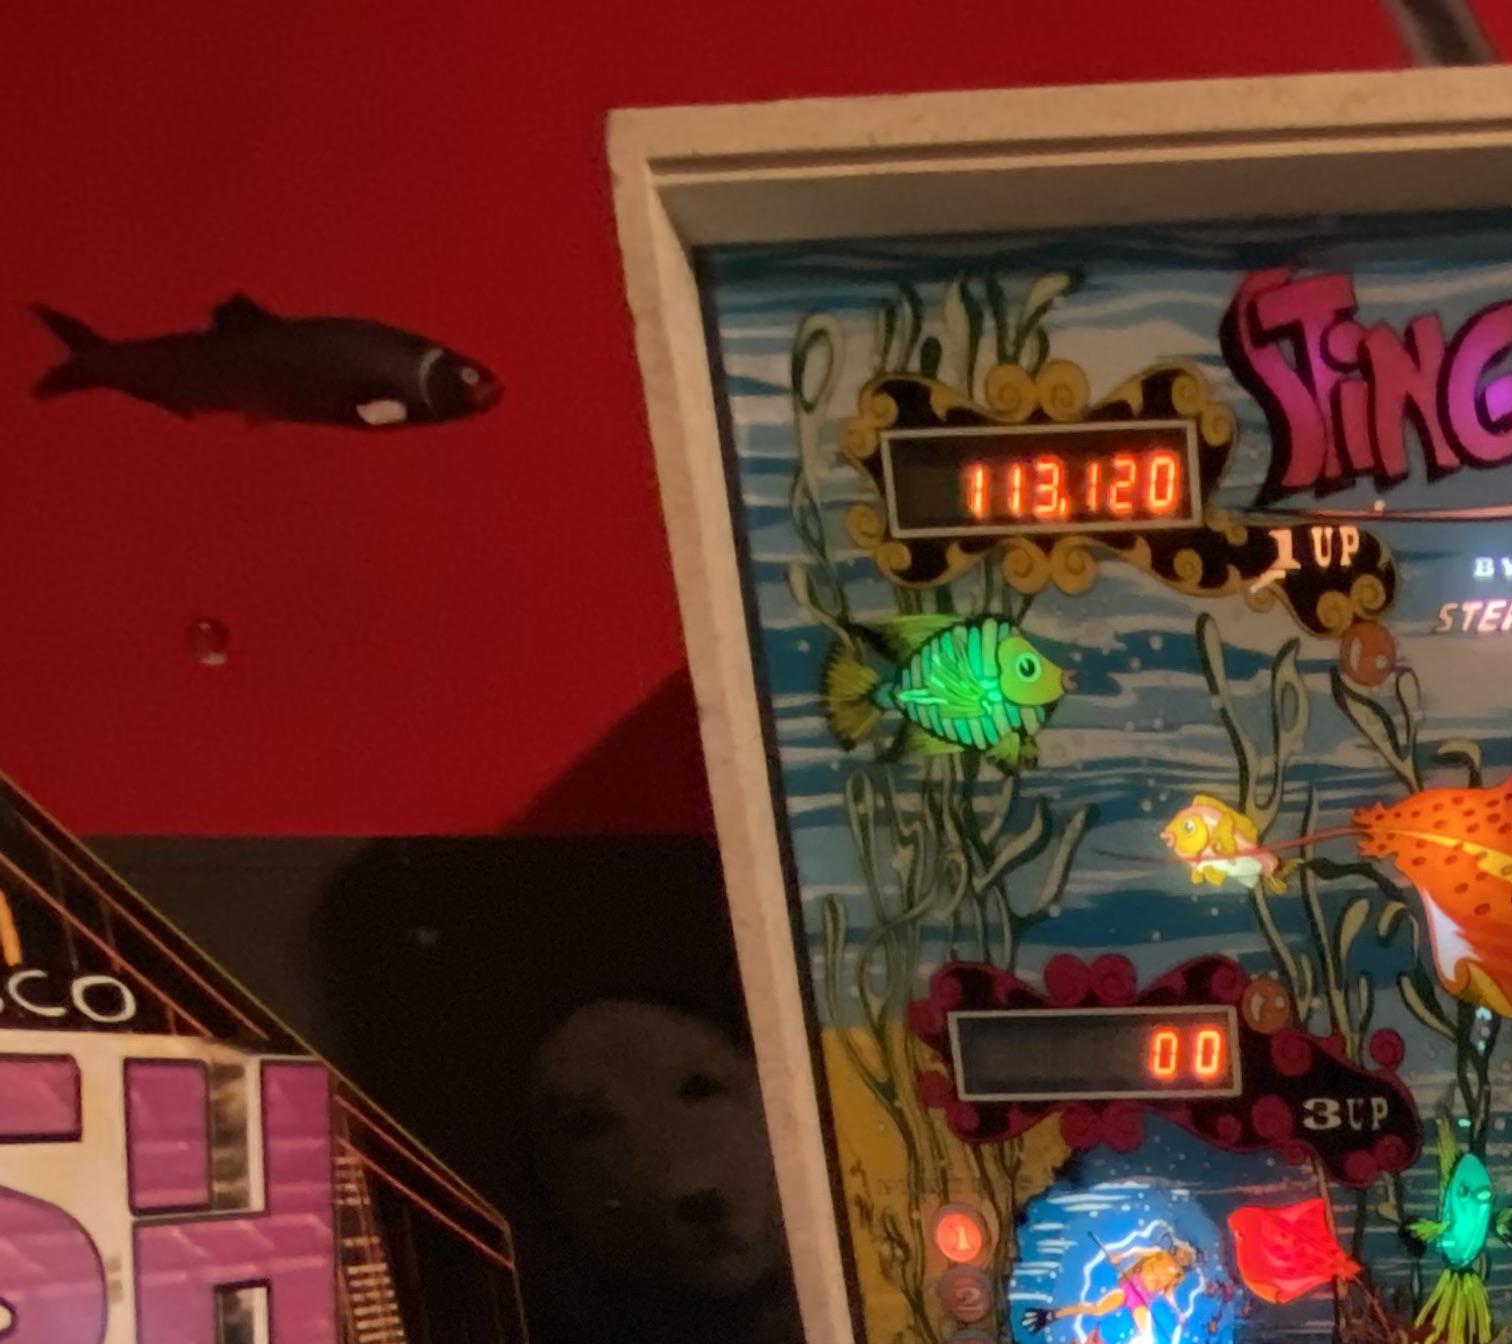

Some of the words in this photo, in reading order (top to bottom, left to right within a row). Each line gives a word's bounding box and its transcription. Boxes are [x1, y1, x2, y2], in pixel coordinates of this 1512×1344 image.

[1275, 528, 1301, 570] 1
[1313, 526, 1360, 567] UP
[0, 969, 136, 1023] CO
[1152, 1028, 1224, 1079] 00
[1302, 1099, 1341, 1130] 3
[1347, 1096, 1389, 1130] UP
[951, 1224, 971, 1251] 1
